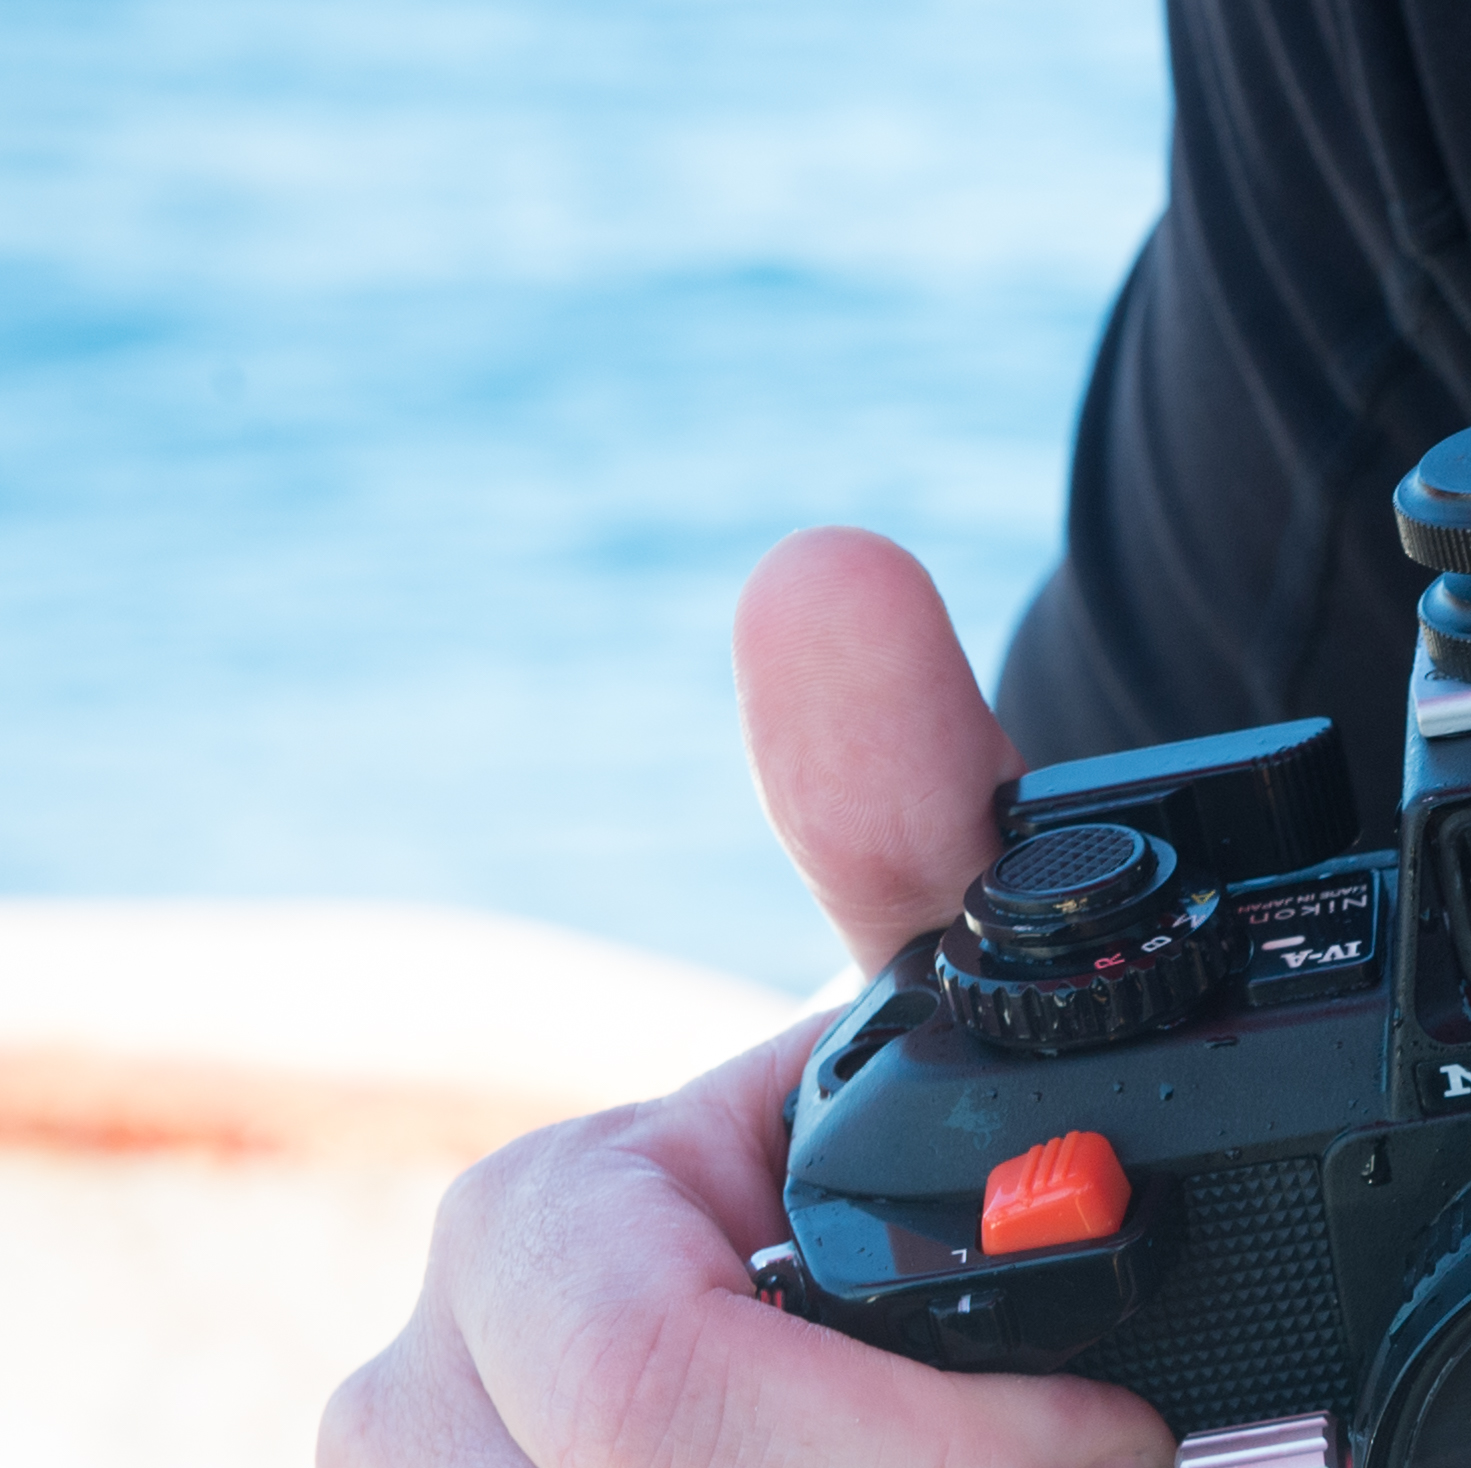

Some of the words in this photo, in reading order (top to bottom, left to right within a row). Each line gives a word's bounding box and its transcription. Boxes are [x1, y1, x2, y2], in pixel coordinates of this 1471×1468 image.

[1140, 935, 1173, 953] B
[1094, 952, 1126, 970] R
[1279, 940, 1363, 969] IV-A
